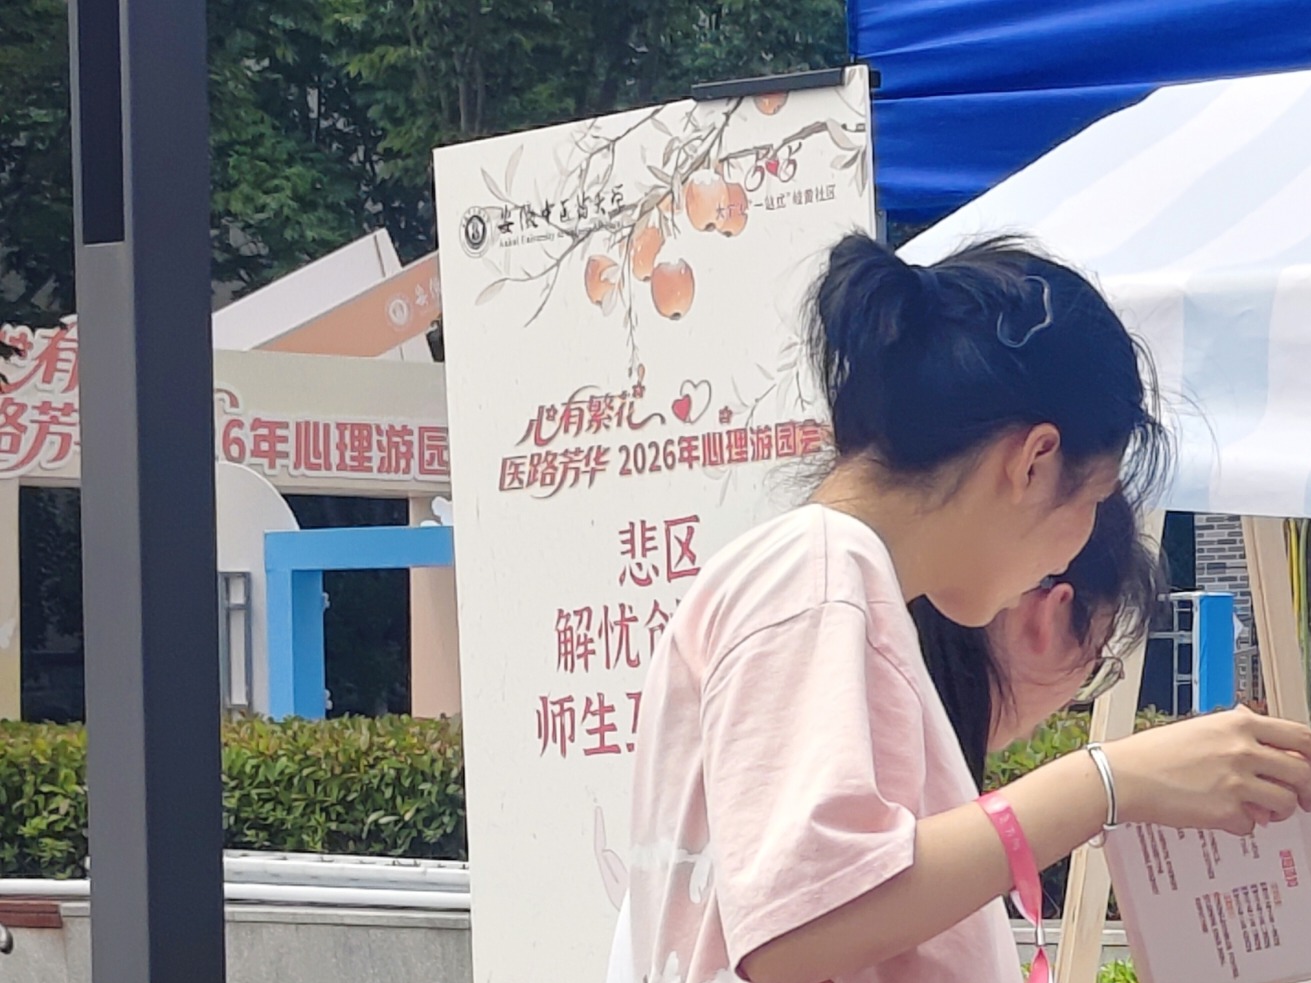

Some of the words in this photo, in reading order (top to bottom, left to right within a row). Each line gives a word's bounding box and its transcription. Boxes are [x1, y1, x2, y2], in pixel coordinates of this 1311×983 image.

[515, 384, 667, 447] 心有繁花
[500, 444, 611, 500] 医路芳华
[618, 514, 701, 587] 悲区
